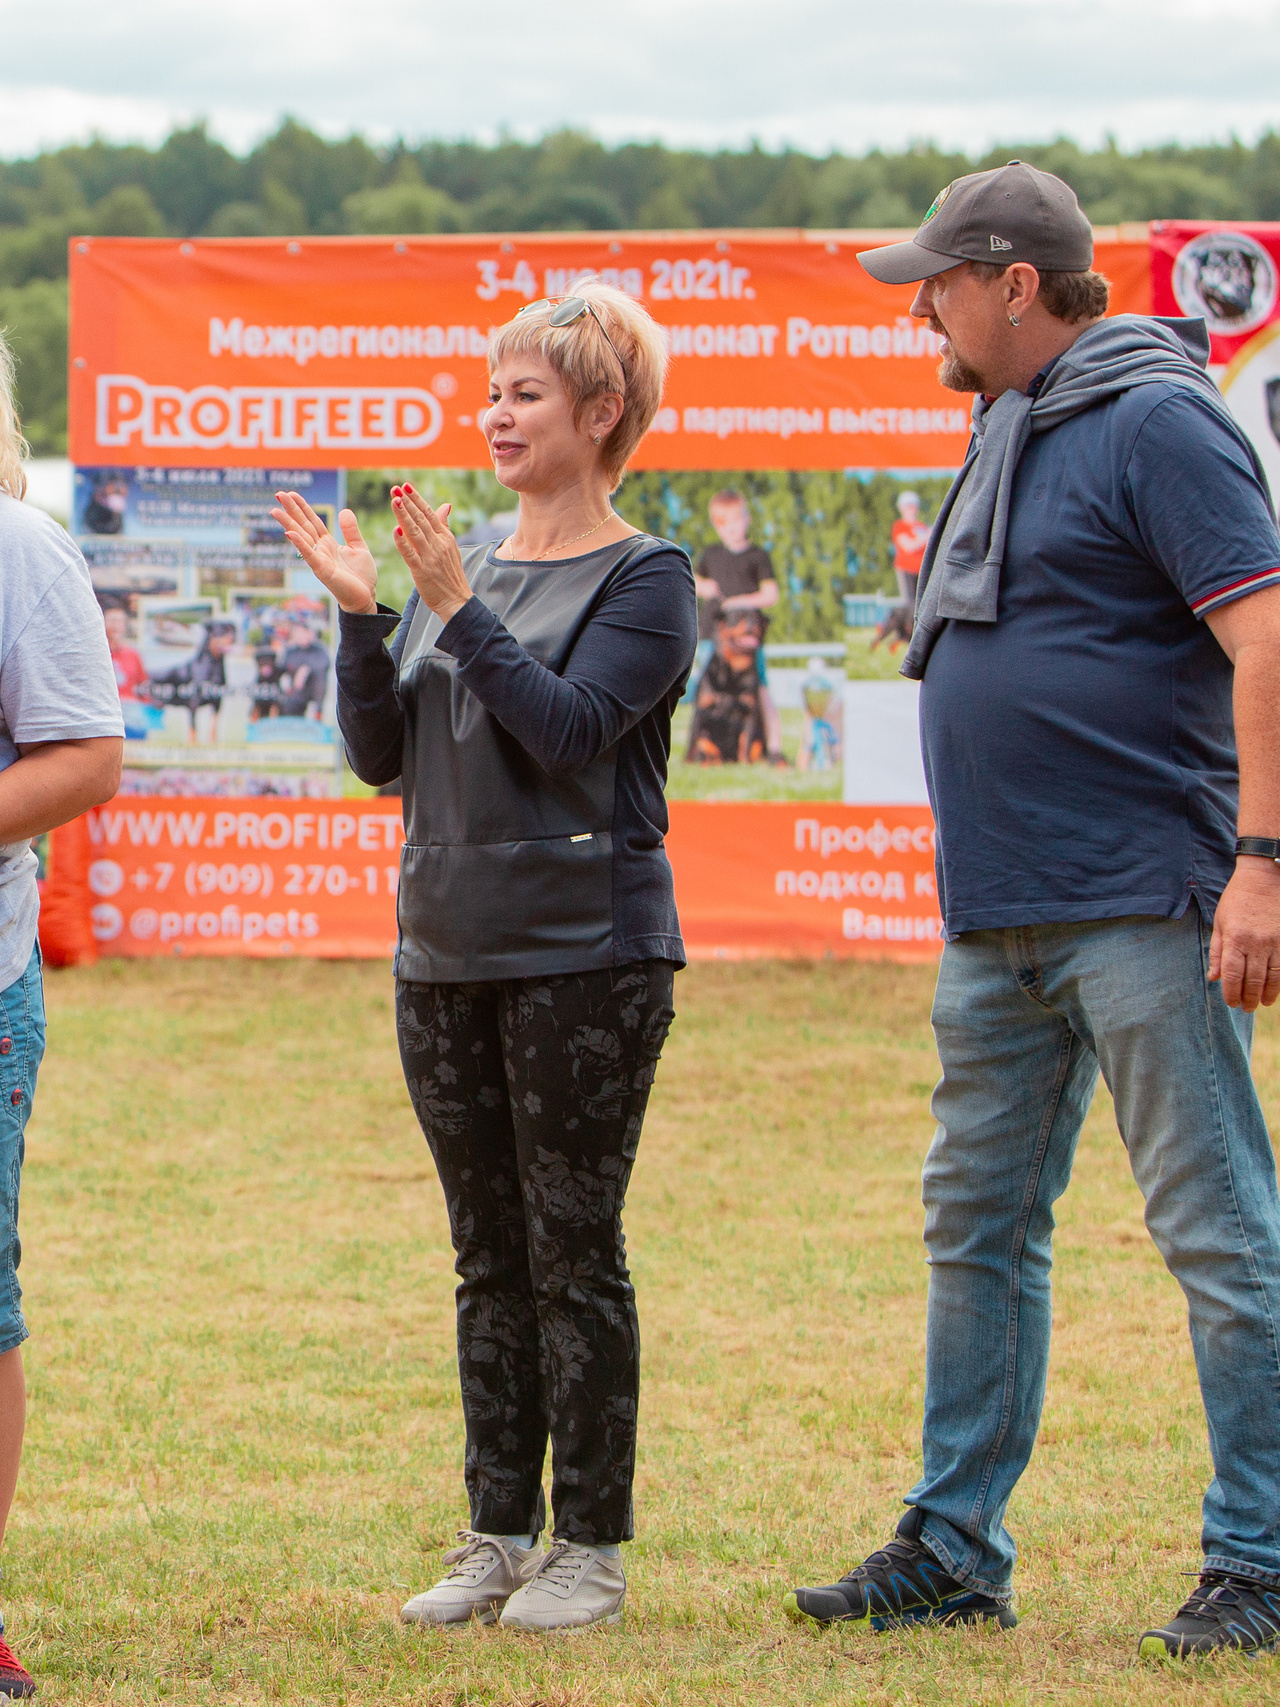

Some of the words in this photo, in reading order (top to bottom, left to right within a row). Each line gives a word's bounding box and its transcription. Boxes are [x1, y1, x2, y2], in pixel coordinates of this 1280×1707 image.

[475, 258, 539, 301] 3-4
[649, 257, 757, 300] 2021г.
[208, 316, 496, 365] Межрегиональ
[662, 322, 779, 358] ионат
[786, 314, 947, 358] Ротвейл
[95, 373, 444, 449] PROFIFEED
[682, 406, 824, 440] партнеры
[827, 406, 968, 434] выставки
[86, 809, 405, 850] WWW.PROFIPET
[793, 817, 937, 859] Профес
[129, 861, 176, 893] +7
[183, 860, 275, 899] (909)
[283, 863, 399, 897] 270-11
[774, 869, 908, 902] подход
[914, 870, 937, 898] к
[129, 903, 320, 943] @profipets
